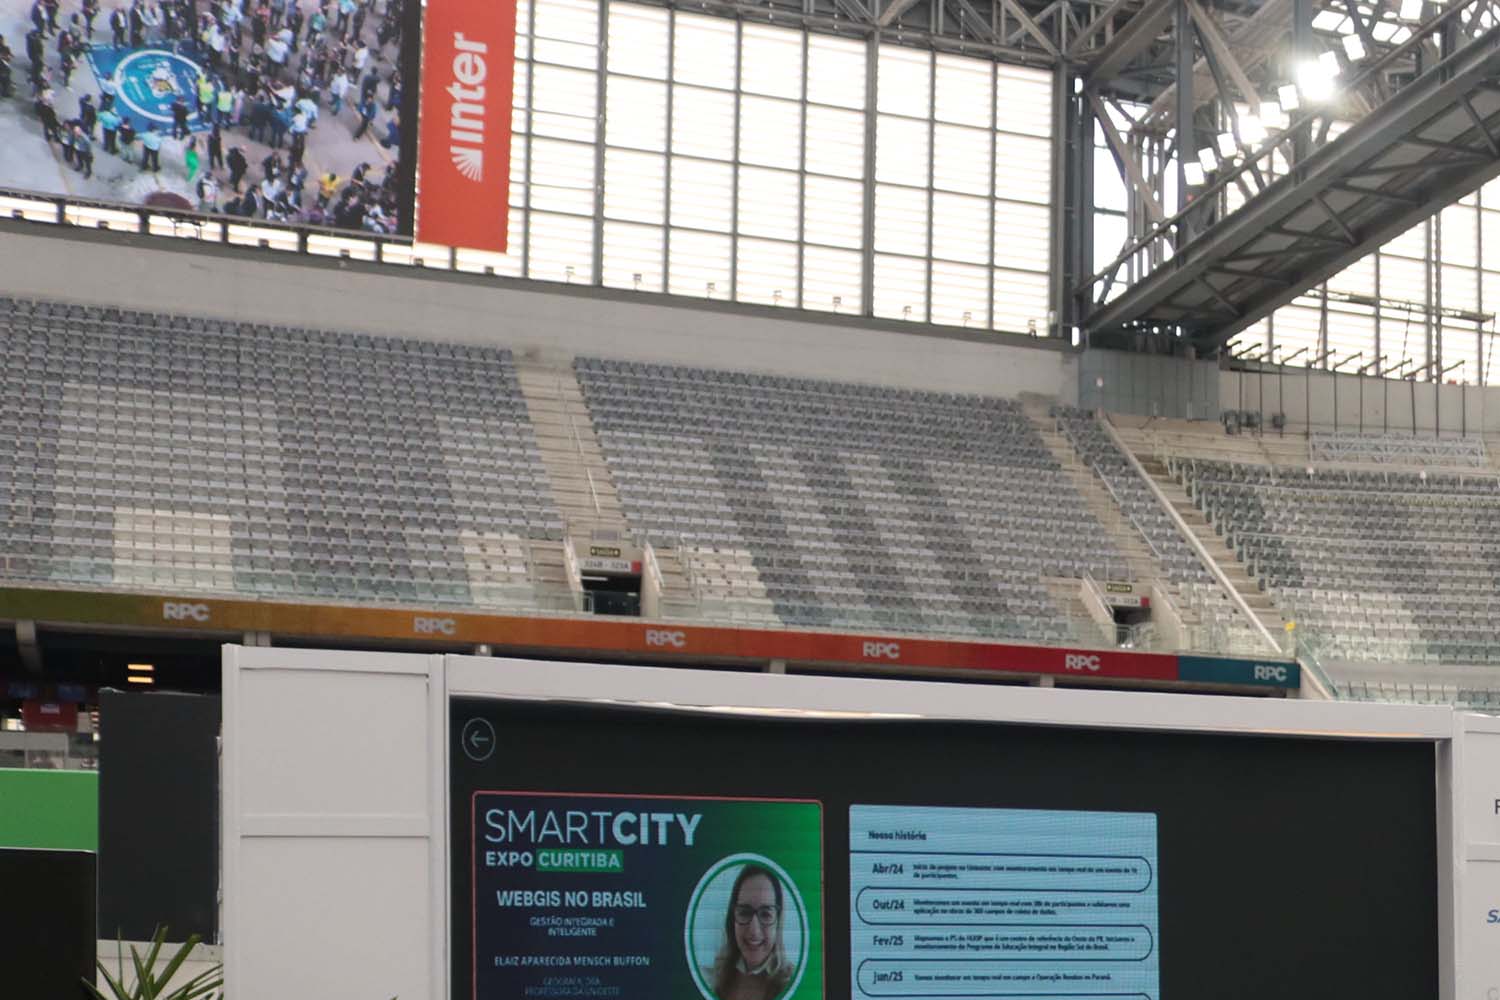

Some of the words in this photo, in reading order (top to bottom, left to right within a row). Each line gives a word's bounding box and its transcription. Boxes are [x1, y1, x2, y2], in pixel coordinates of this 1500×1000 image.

[163, 602, 208, 622] RPC
[414, 617, 455, 636] RPC
[646, 629, 687, 648] RPC
[863, 642, 899, 660] RPC
[1065, 653, 1100, 672] RPC
[1254, 665, 1287, 682] RPC
[485, 808, 702, 847] SMARTCITY
[486, 851, 533, 868] EXPO
[538, 850, 621, 869] CURITIBA
[872, 863, 904, 875] Abr/24
[496, 890, 561, 907] WEBGIS
[565, 891, 589, 908] NO
[591, 891, 648, 908] BRASIL
[873, 899, 904, 911] Out/24
[873, 935, 904, 947] Fev/25
[521, 955, 572, 966] APARECIDA
[873, 971, 903, 985] Jun/25
